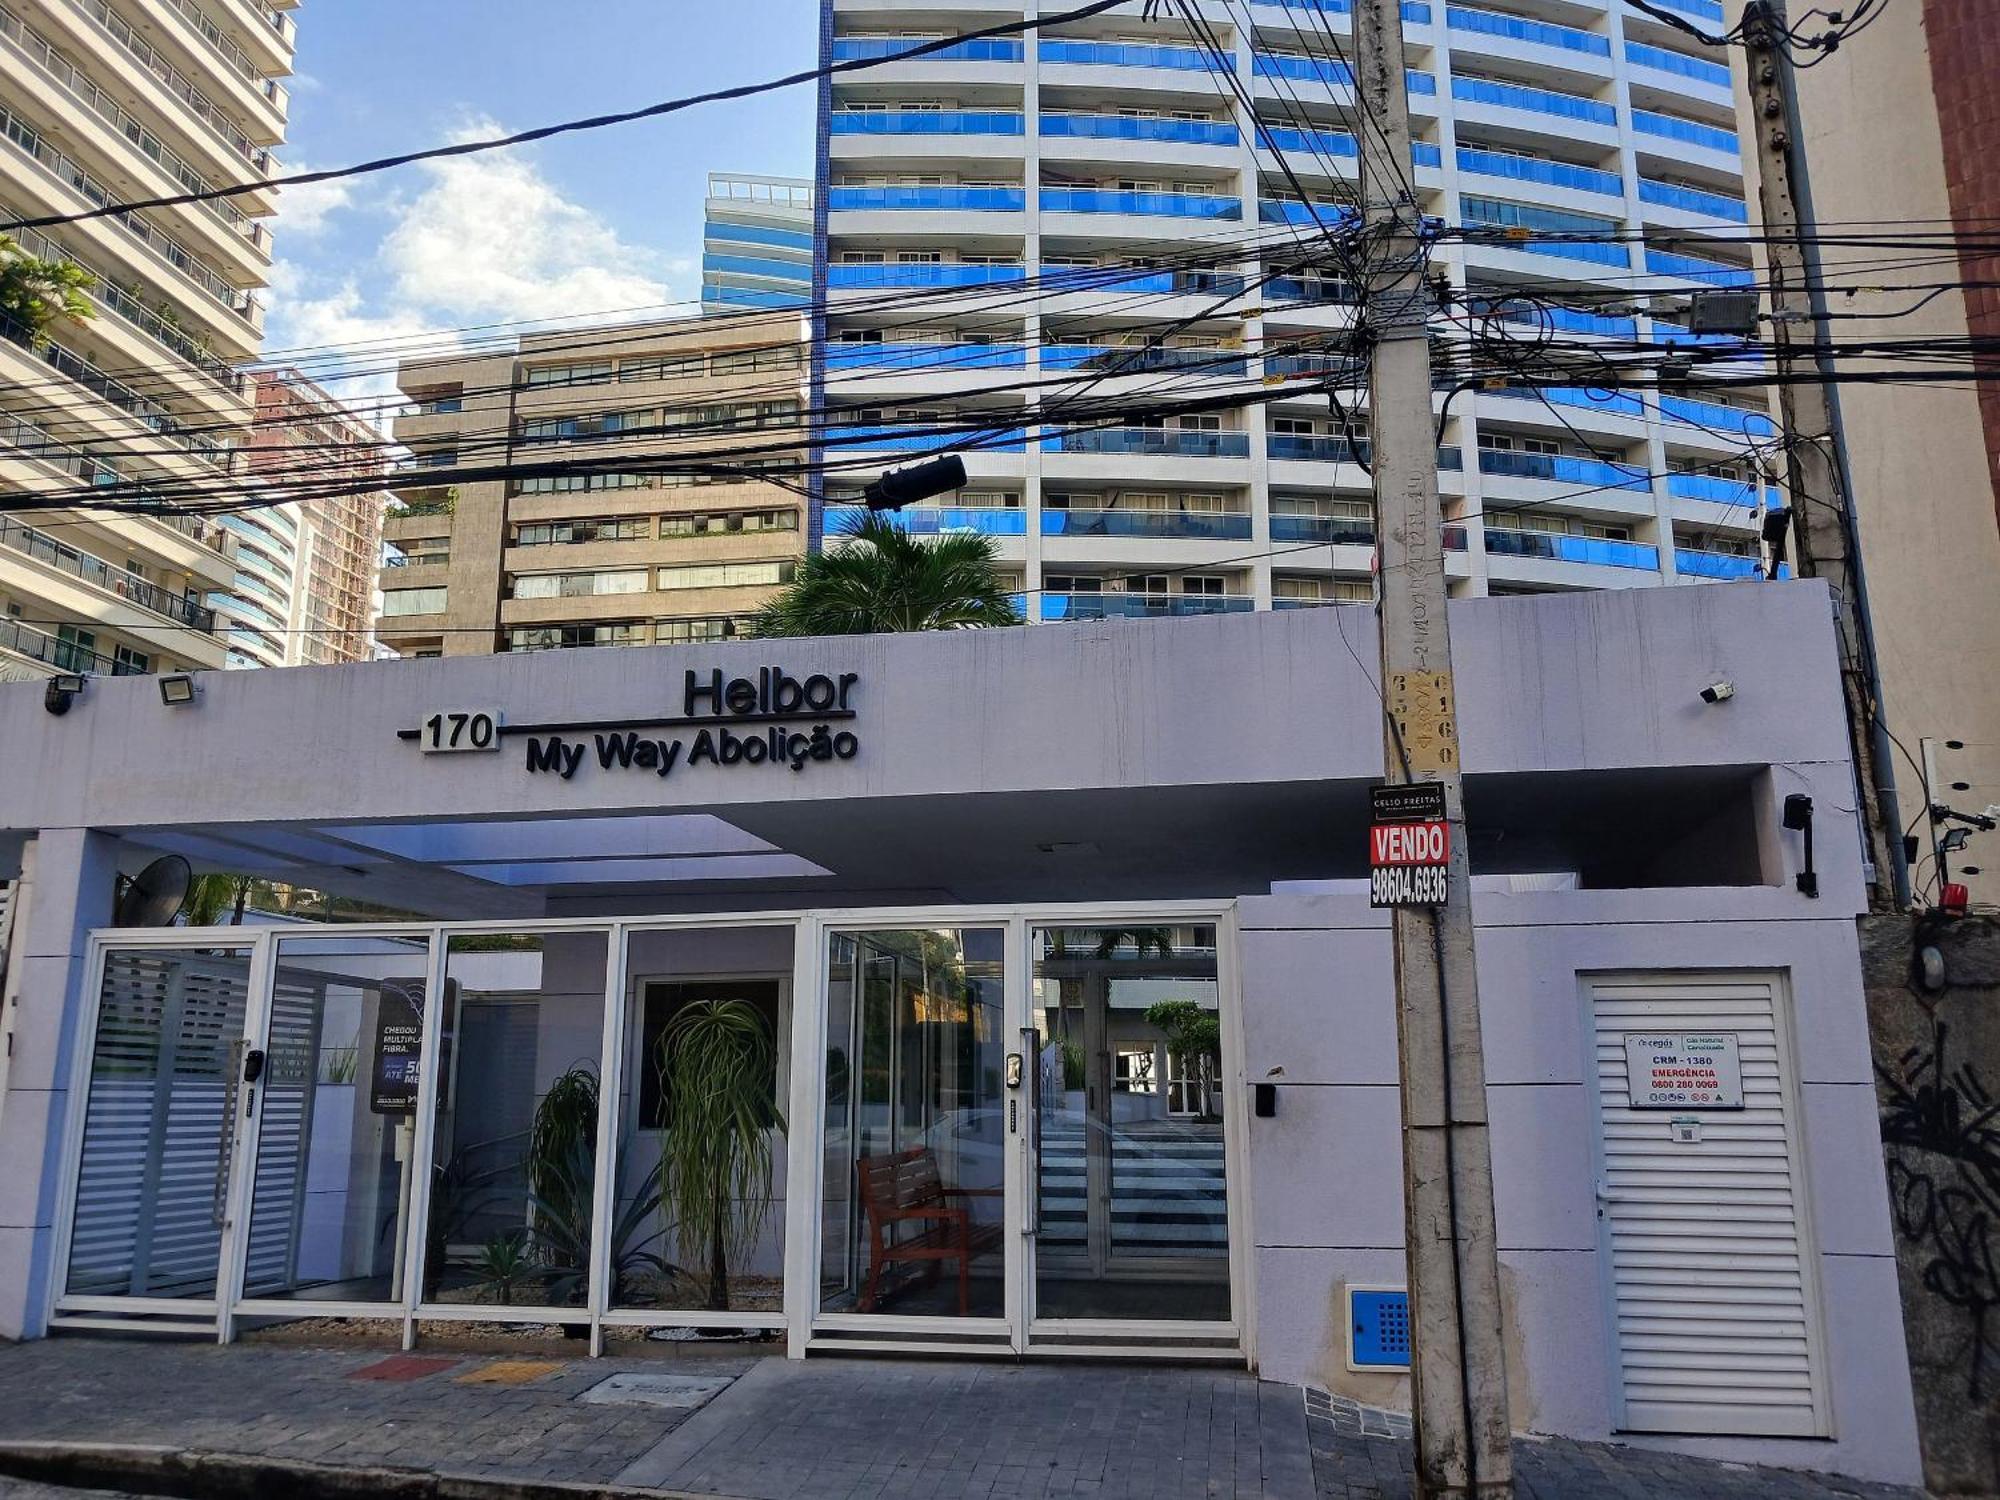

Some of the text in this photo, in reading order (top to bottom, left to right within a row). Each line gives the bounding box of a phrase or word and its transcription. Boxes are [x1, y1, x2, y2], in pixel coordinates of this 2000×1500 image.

[684, 666, 857, 716] Helbor
[426, 713, 493, 749] 170
[526, 724, 859, 779] My Way Abolição
[1375, 825, 1443, 861] VENDO
[1372, 865, 1447, 904] 98604.6936
[1652, 1068, 1715, 1077] EMERGÊNCIA
[1653, 1056, 1677, 1065] CRM
[1687, 1057, 1713, 1065] 1380
[1652, 1080, 1674, 1089] 0800
[1676, 1080, 1693, 1089] 280
